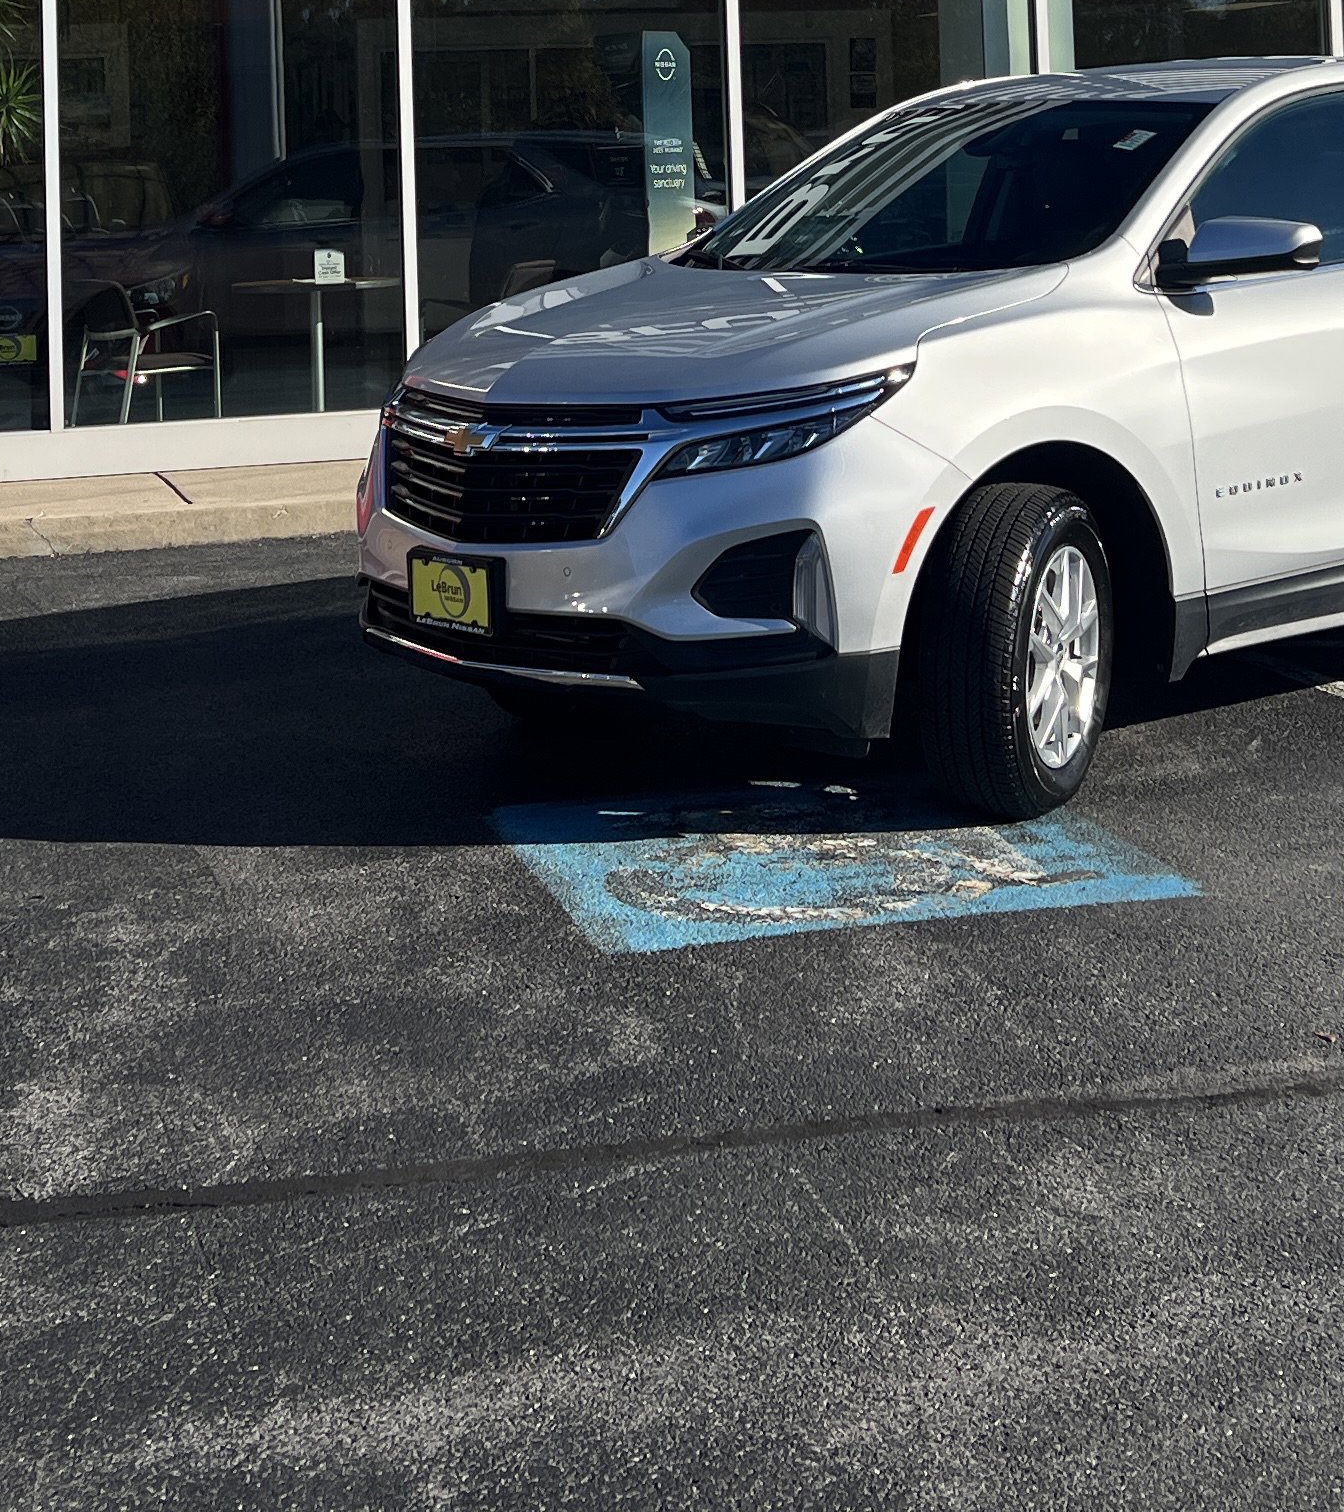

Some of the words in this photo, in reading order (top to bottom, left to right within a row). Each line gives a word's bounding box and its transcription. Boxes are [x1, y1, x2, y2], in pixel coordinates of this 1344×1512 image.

[649, 164, 665, 173] Your
[666, 163, 687, 175] driving
[653, 178, 685, 189] sanctuary
[1215, 472, 1303, 498] EQUINOX
[431, 580, 462, 595] LeBrun
